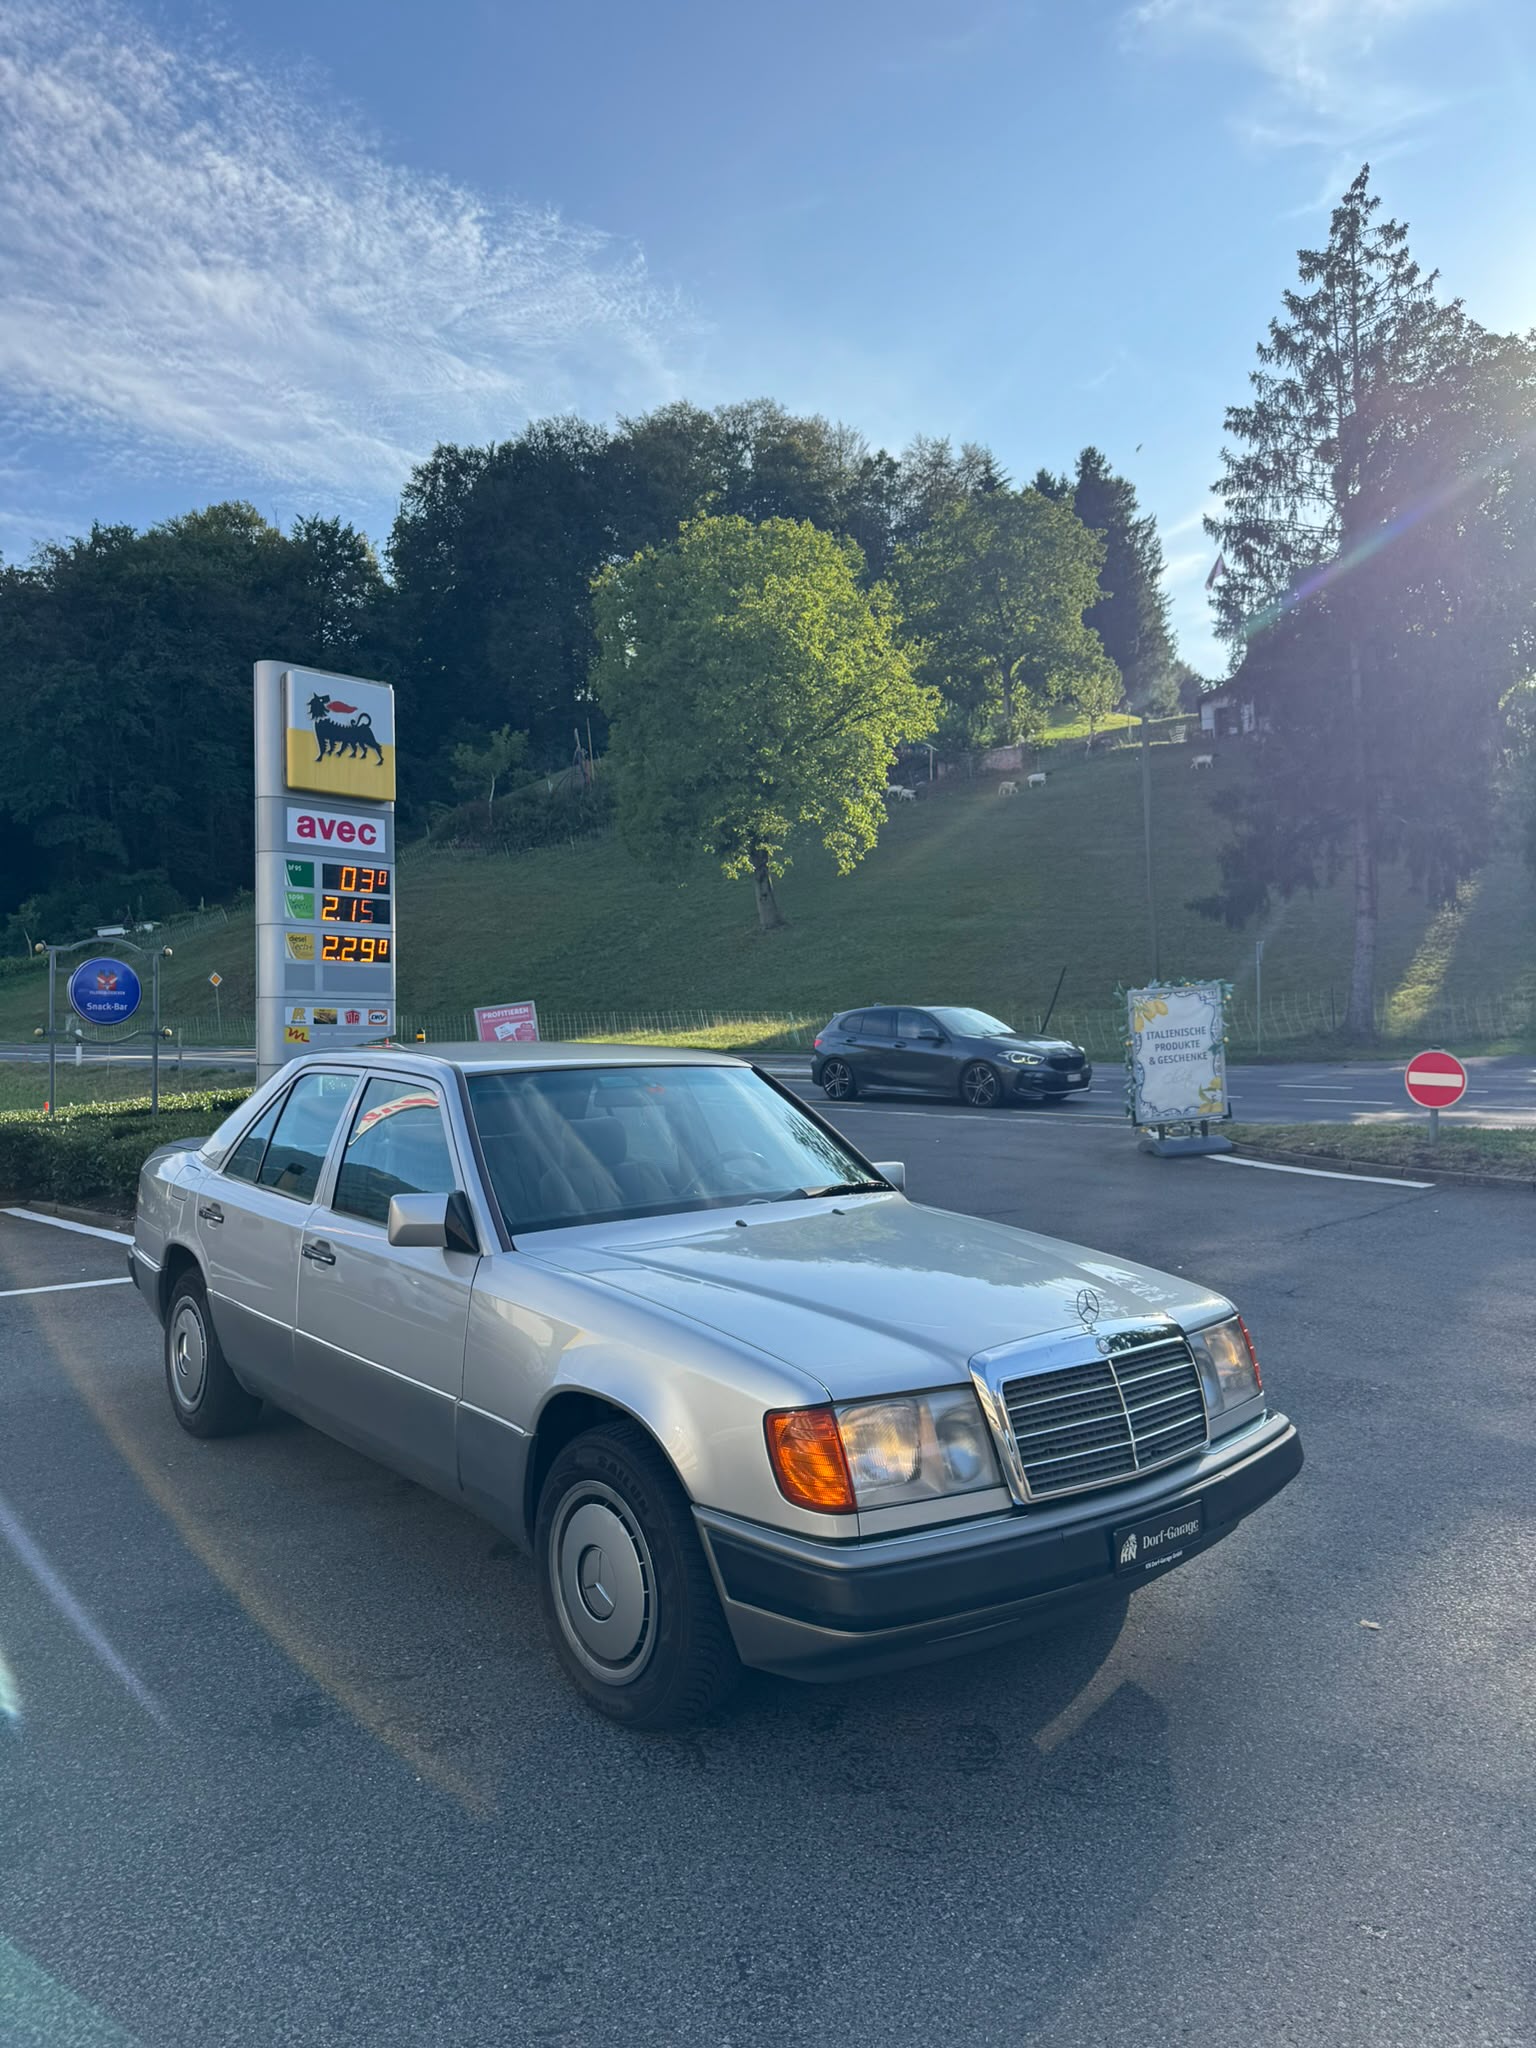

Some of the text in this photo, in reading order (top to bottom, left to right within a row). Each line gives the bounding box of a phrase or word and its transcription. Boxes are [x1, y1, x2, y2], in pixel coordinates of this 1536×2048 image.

[297, 815, 377, 845] avec
[321, 896, 374, 923] 2.15
[289, 935, 307, 943] diesel
[86, 1002, 128, 1011] Snack-Bar
[482, 1007, 529, 1019] PROFITIEREN
[1146, 1026, 1207, 1040] ITALIENISCHE
[1154, 1040, 1201, 1052] PRODUKTE
[1149, 1052, 1208, 1065] & GESCHENKE
[1143, 1520, 1199, 1549] Dorf-Garage
